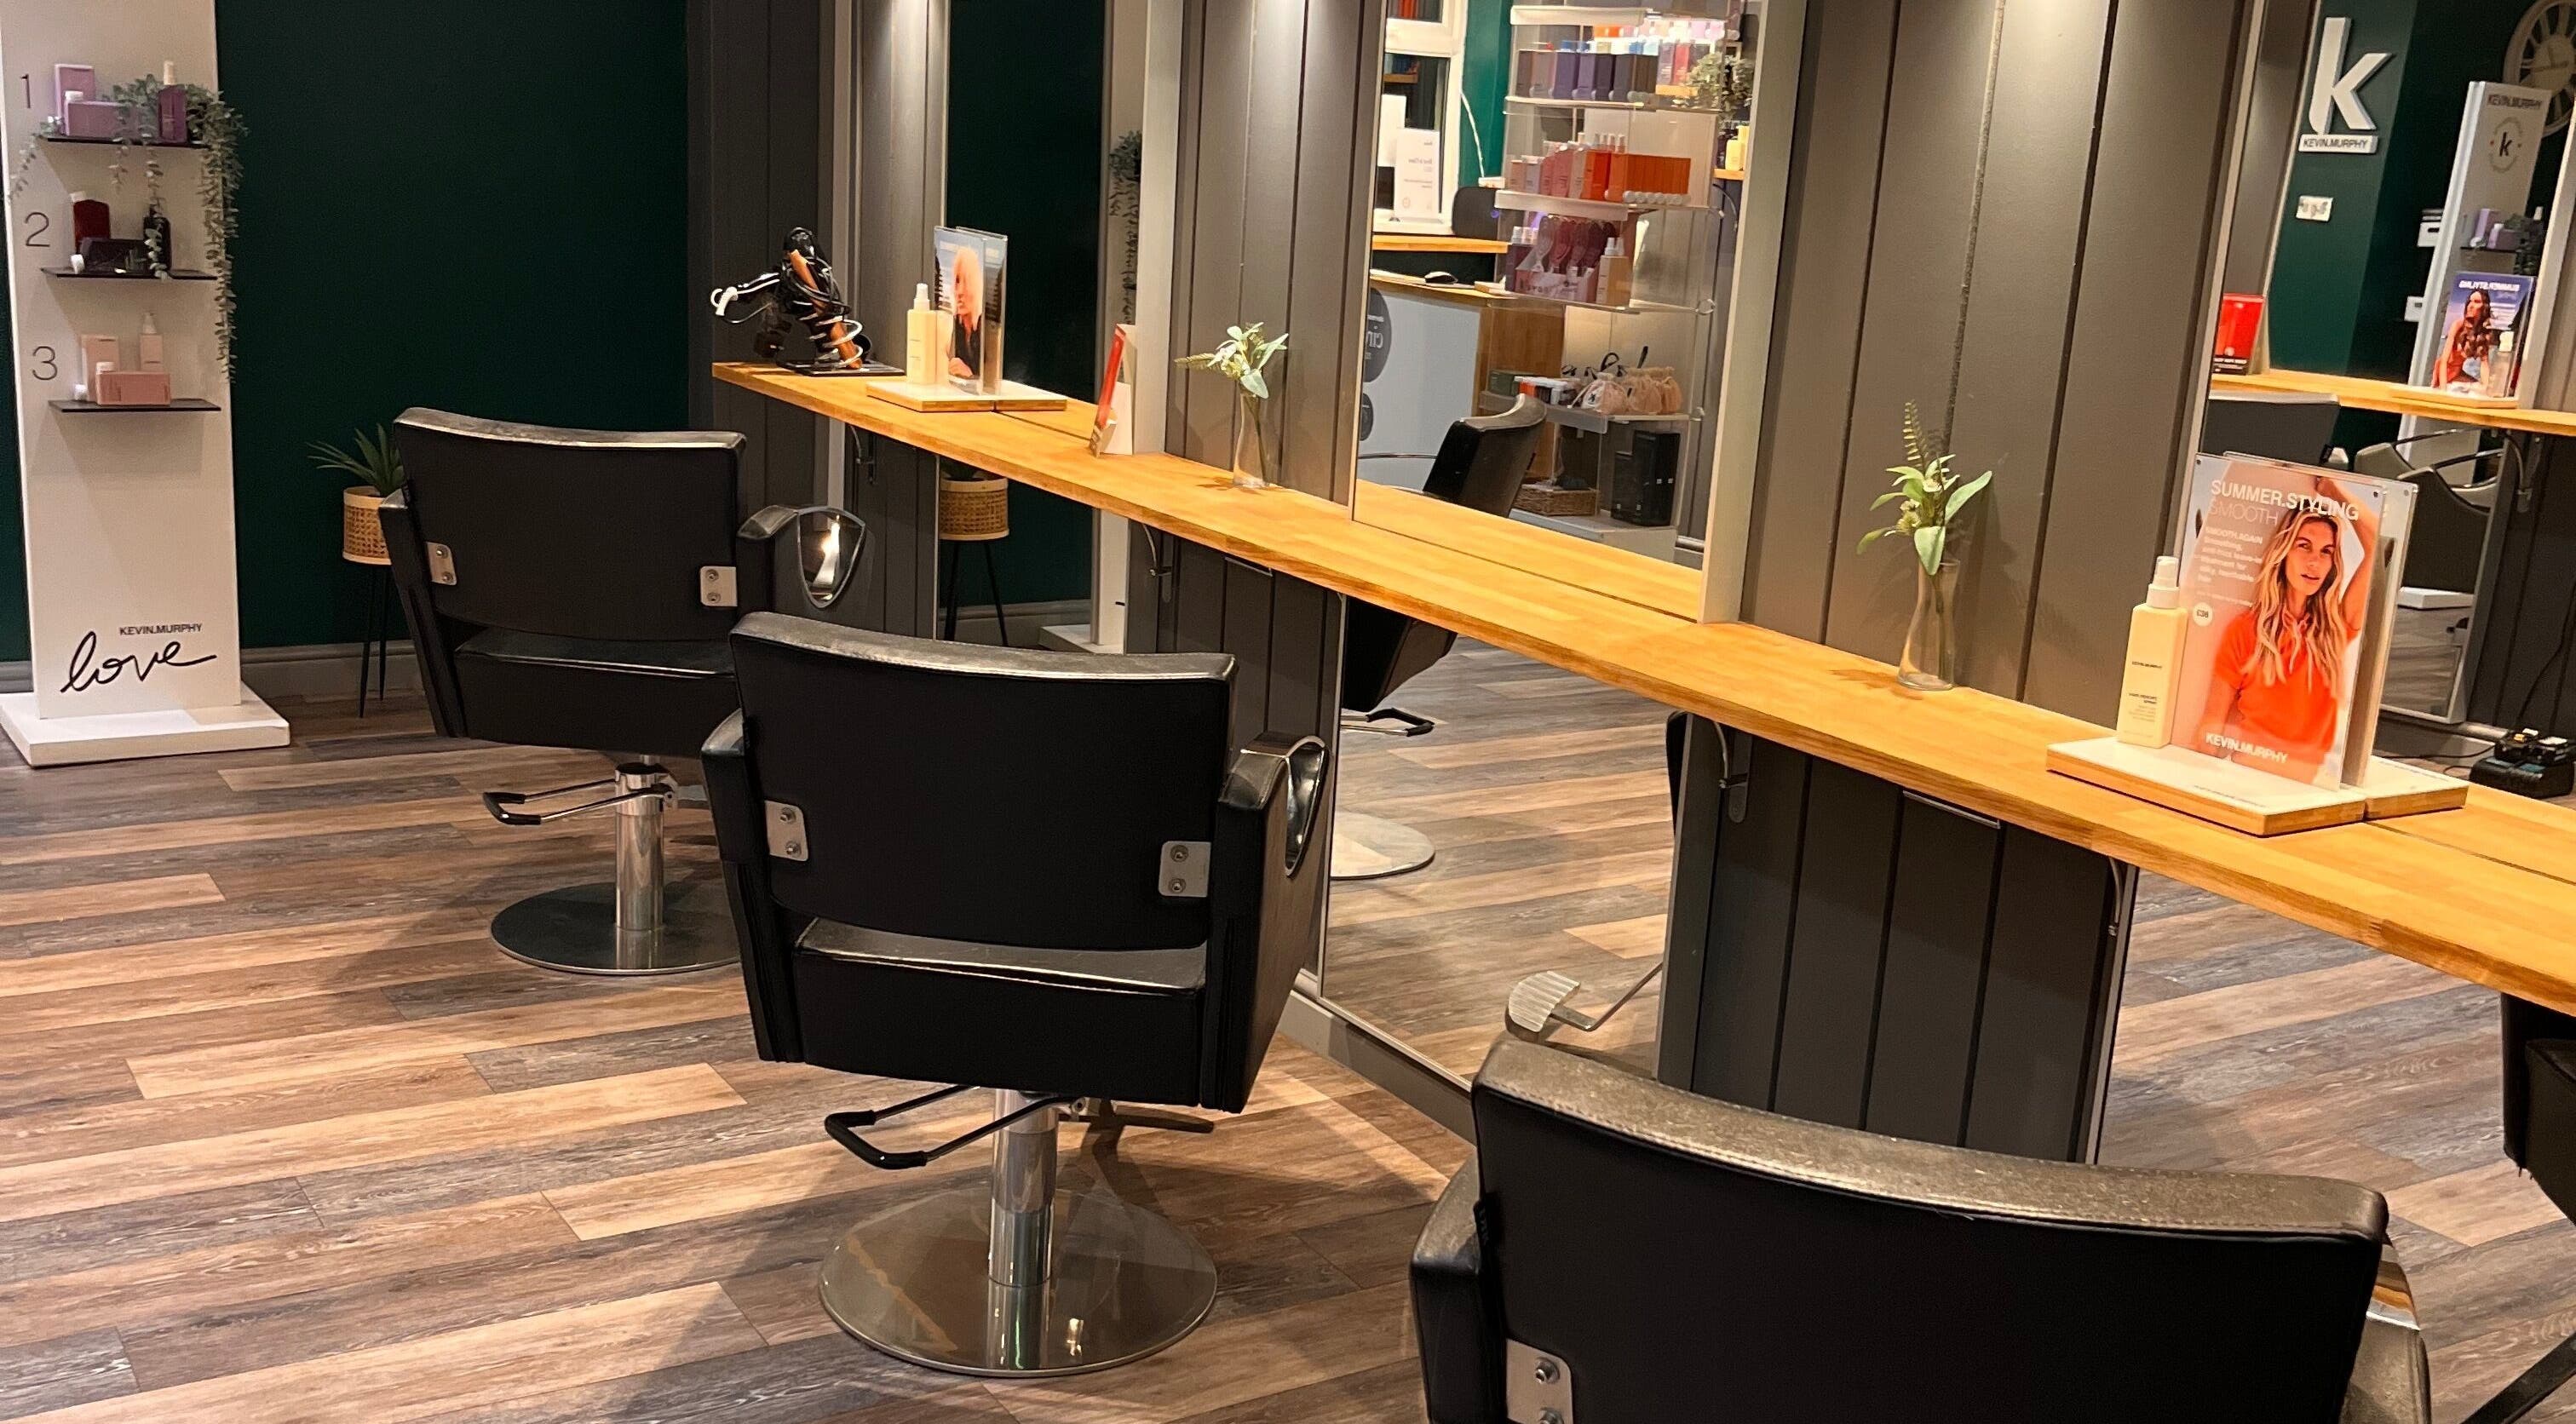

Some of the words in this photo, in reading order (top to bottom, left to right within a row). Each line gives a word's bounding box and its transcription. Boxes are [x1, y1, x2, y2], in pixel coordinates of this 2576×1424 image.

[20, 74, 31, 108] 1
[2309, 17, 2392, 135] k
[2303, 138, 2368, 148] KEVIN.MURPHY
[24, 212, 50, 247] 2
[32, 346, 58, 381] 3
[2210, 500, 2279, 525] SMOOTH
[2211, 479, 2359, 521] SUMMER.STYLING
[118, 623, 203, 635] KEVIN.MURPHY
[60, 631, 217, 692] love
[2205, 733, 2289, 764] KEVIN.MURPHY
